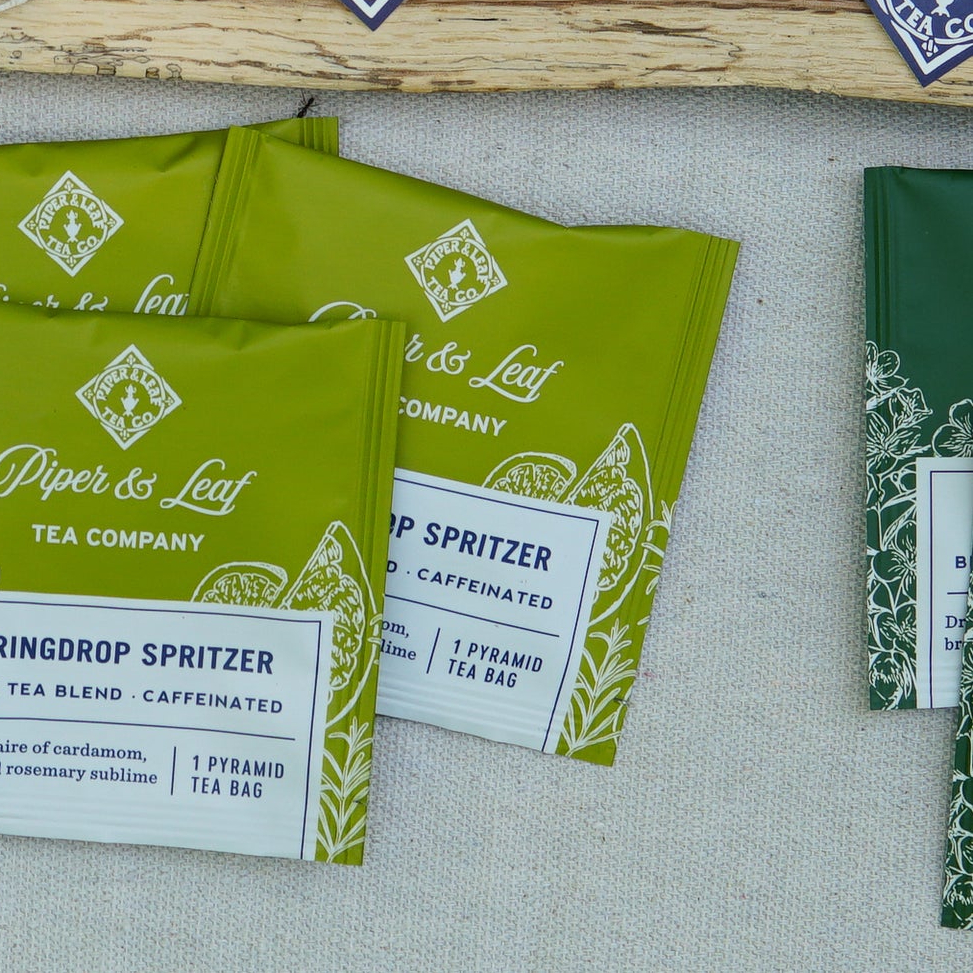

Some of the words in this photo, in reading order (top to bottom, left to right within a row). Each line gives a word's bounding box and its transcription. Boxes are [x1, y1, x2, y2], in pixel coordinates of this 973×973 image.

[38, 194, 69, 230] PIPER
[46, 235, 71, 255] TEA
[424, 240, 460, 271] PIPER
[427, 276, 449, 301] TEA
[96, 368, 128, 402] PIPER
[426, 341, 471, 375] &
[468, 344, 565, 403] Leaf
[101, 407, 126, 428] TEA
[114, 466, 158, 500] &
[159, 458, 258, 517] Leaf
[32, 523, 78, 546] TEA
[86, 527, 205, 552] COMPANY
[423, 522, 552, 572] SPRITZER
[417, 568, 553, 610] CAFFEINATED
[141, 642, 274, 675] SPRITZER
[453, 639, 461, 654] 1
[468, 642, 543, 673] PYRAMID
[448, 659, 476, 680] TEA
[484, 667, 518, 689] BAG
[7, 682, 46, 697] TEA
[55, 684, 122, 701] BLEND
[143, 690, 283, 714] CAFFEINATED
[32, 741, 51, 754] of
[53, 743, 147, 763] cardamom,
[192, 755, 200, 771] 1
[208, 756, 285, 779] PYRAMID
[6, 765, 86, 782] rosemary
[89, 767, 158, 784] sublime
[191, 777, 221, 795] TEA
[230, 780, 263, 799] BAG
